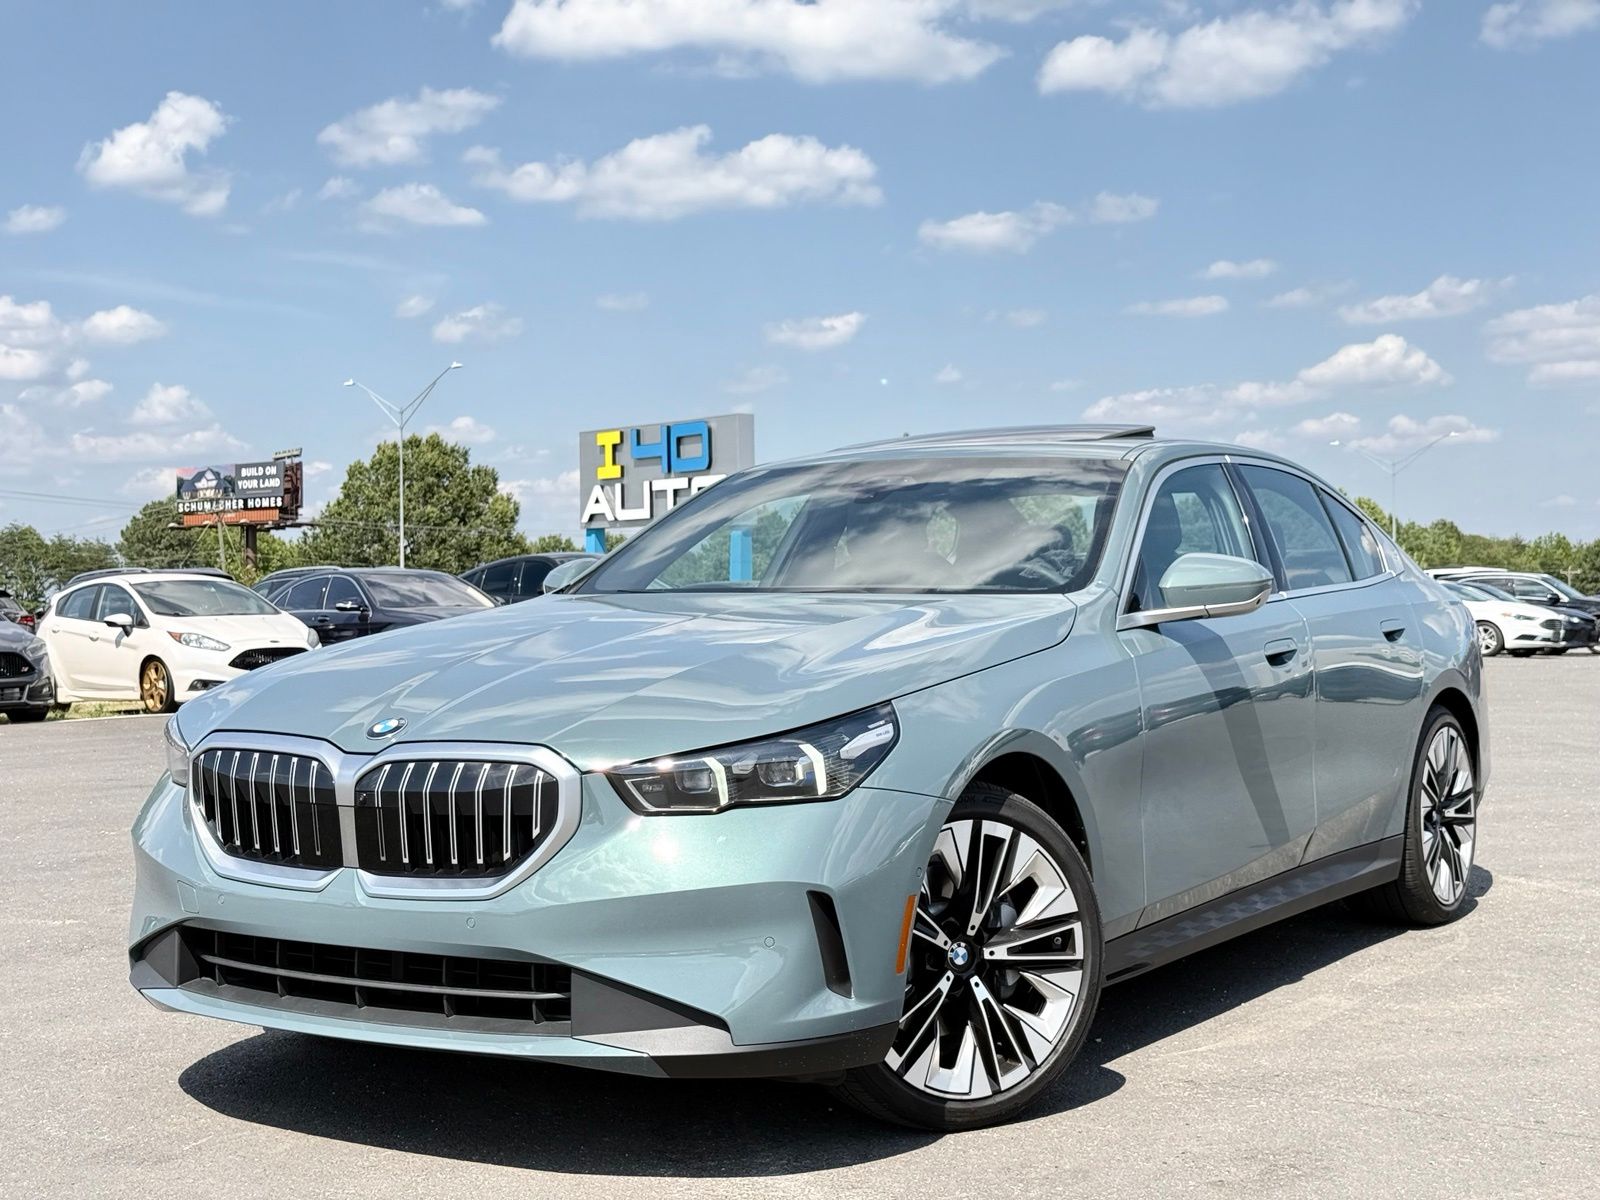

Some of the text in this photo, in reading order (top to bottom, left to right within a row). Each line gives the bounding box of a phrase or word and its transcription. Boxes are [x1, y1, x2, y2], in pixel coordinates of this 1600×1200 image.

[597, 421, 710, 480] I 40
[241, 466, 277, 477] BUILD ON
[238, 478, 280, 490] YOUR LAND
[247, 497, 283, 508] HOMES
